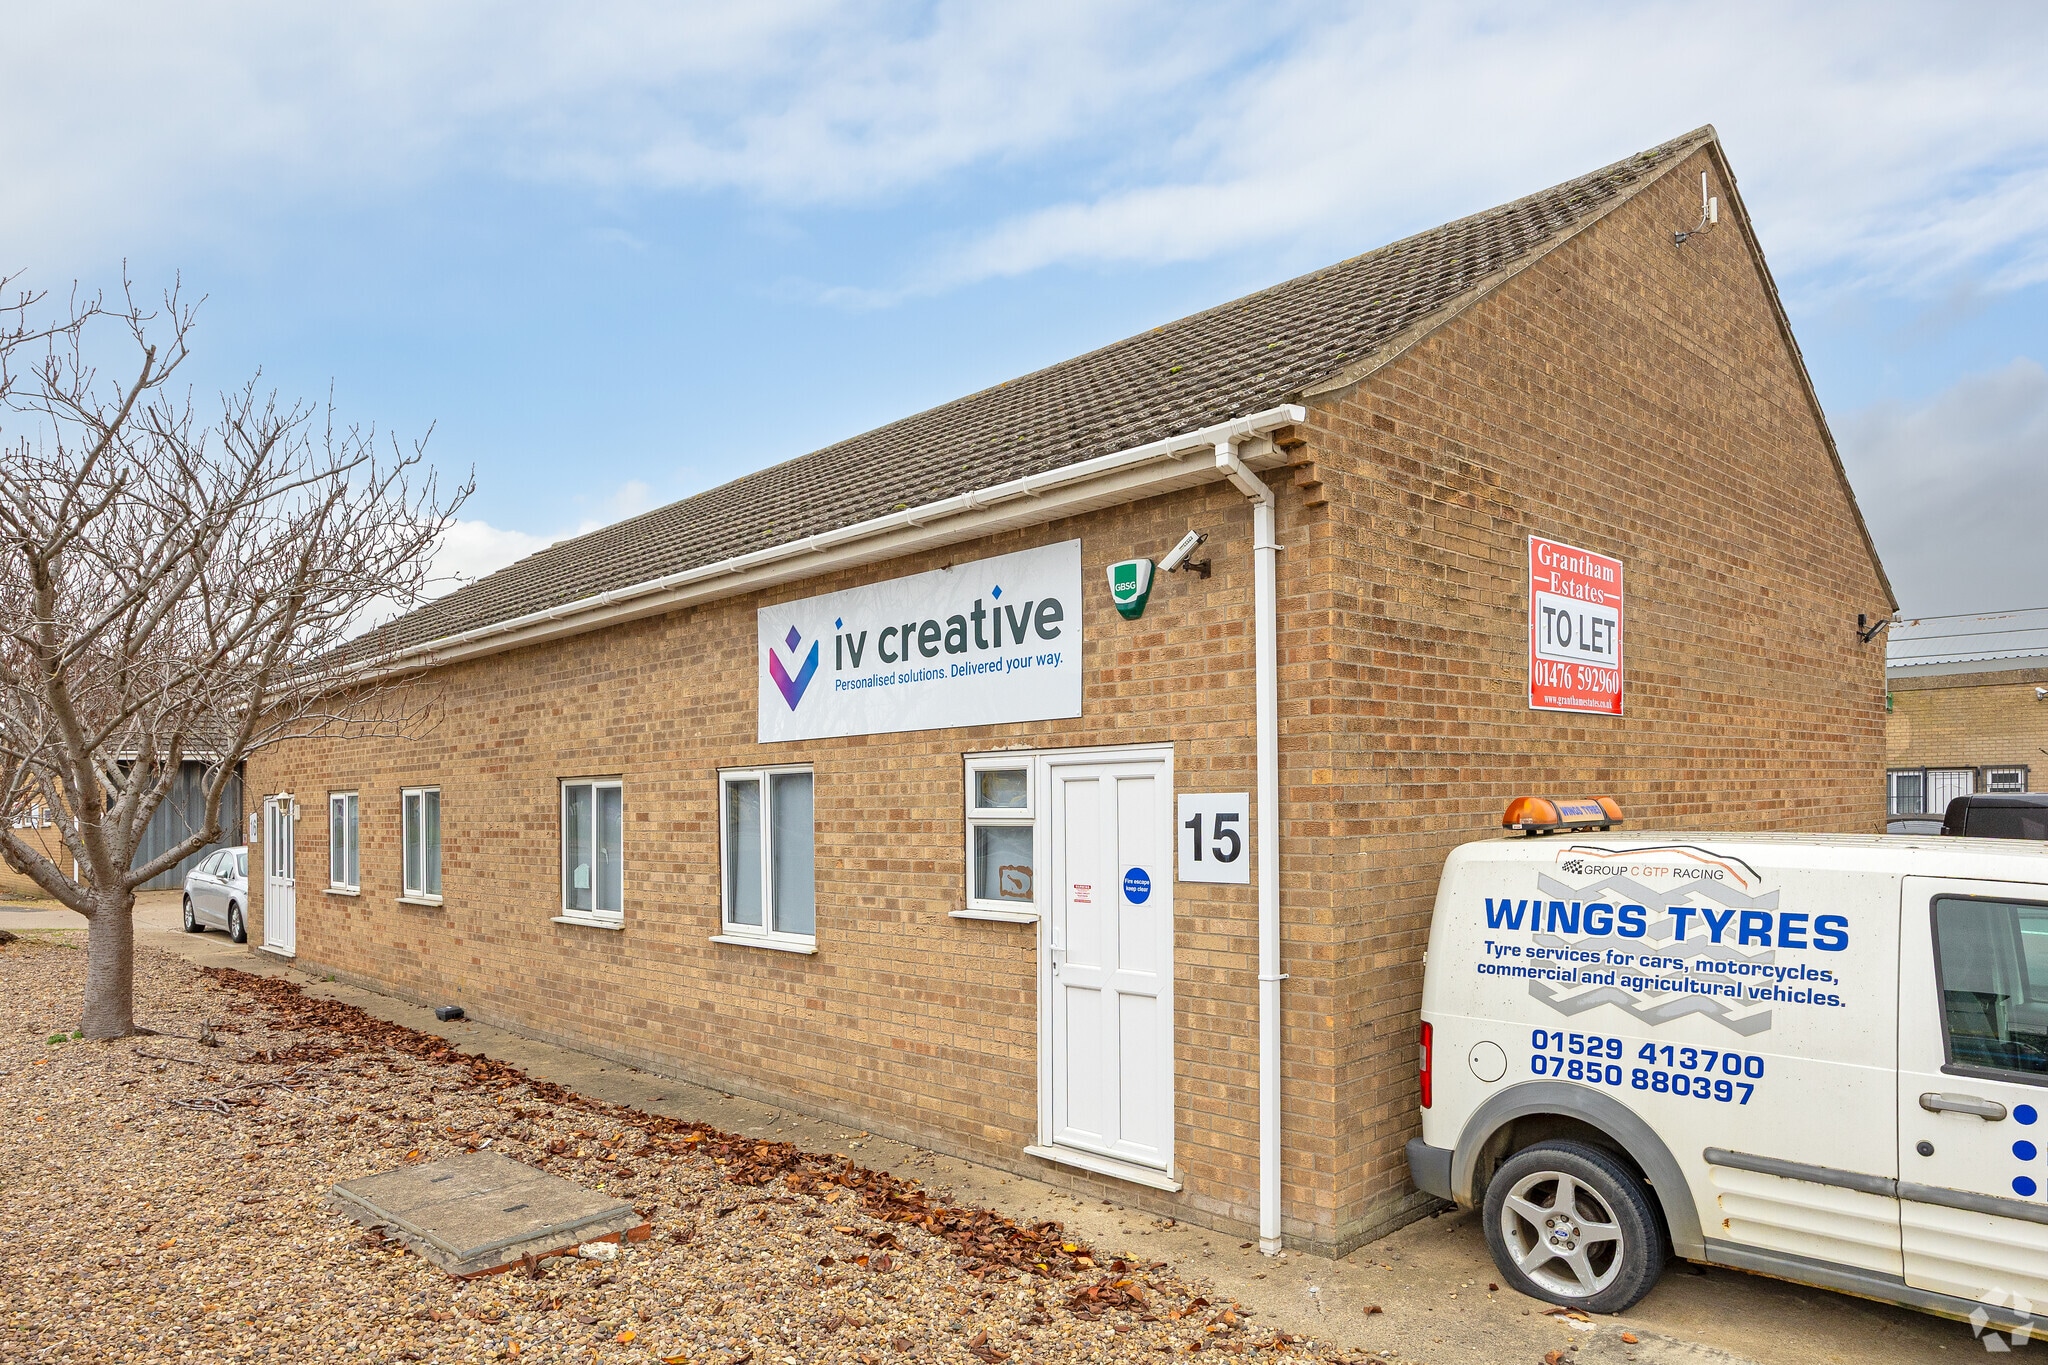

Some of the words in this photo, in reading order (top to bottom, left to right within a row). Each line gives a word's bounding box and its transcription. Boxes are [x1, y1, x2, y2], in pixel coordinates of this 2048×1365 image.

[1537, 543, 1614, 583] Grantham
[1115, 581, 1136, 591] GBSG
[1550, 571, 1604, 604] Estates
[835, 617, 867, 671] iv
[878, 584, 1064, 664] creative
[1542, 606, 1572, 648] TO
[1579, 614, 1615, 655] LET
[835, 672, 896, 691] Personalised
[898, 667, 948, 684] solutions.
[951, 657, 1002, 678] Delivered
[1006, 656, 1033, 674] your
[1036, 652, 1063, 668] way.
[1535, 660, 1572, 690] 01476
[1577, 666, 1619, 695] 592960
[1544, 694, 1613, 710] www.granthamestates.co.uk
[1560, 806, 1583, 816] WINGS
[1582, 805, 1601, 815] TYRES
[1185, 812, 1242, 863] 15
[1584, 865, 1628, 876] GROUP
[1630, 866, 1640, 877] C
[1643, 866, 1669, 877] GTP
[1673, 868, 1724, 880] RACING
[1484, 898, 1647, 939] WINGS
[1668, 906, 1849, 952] TYRES
[1485, 940, 1521, 959] Tyre
[1526, 946, 1601, 963] services
[1606, 949, 1634, 966] for
[1639, 955, 1689, 973] cars,
[1695, 960, 1839, 985] motorcycles,
[1477, 963, 1577, 982] commercial
[1581, 970, 1615, 986] and
[1620, 973, 1742, 998] agricultural
[1748, 985, 1846, 1007] vehicles.
[1532, 1029, 1623, 1060] 01529
[1638, 1042, 1764, 1079] 413700
[1531, 1054, 1622, 1086] 07850
[1631, 1068, 1754, 1105] 880397
